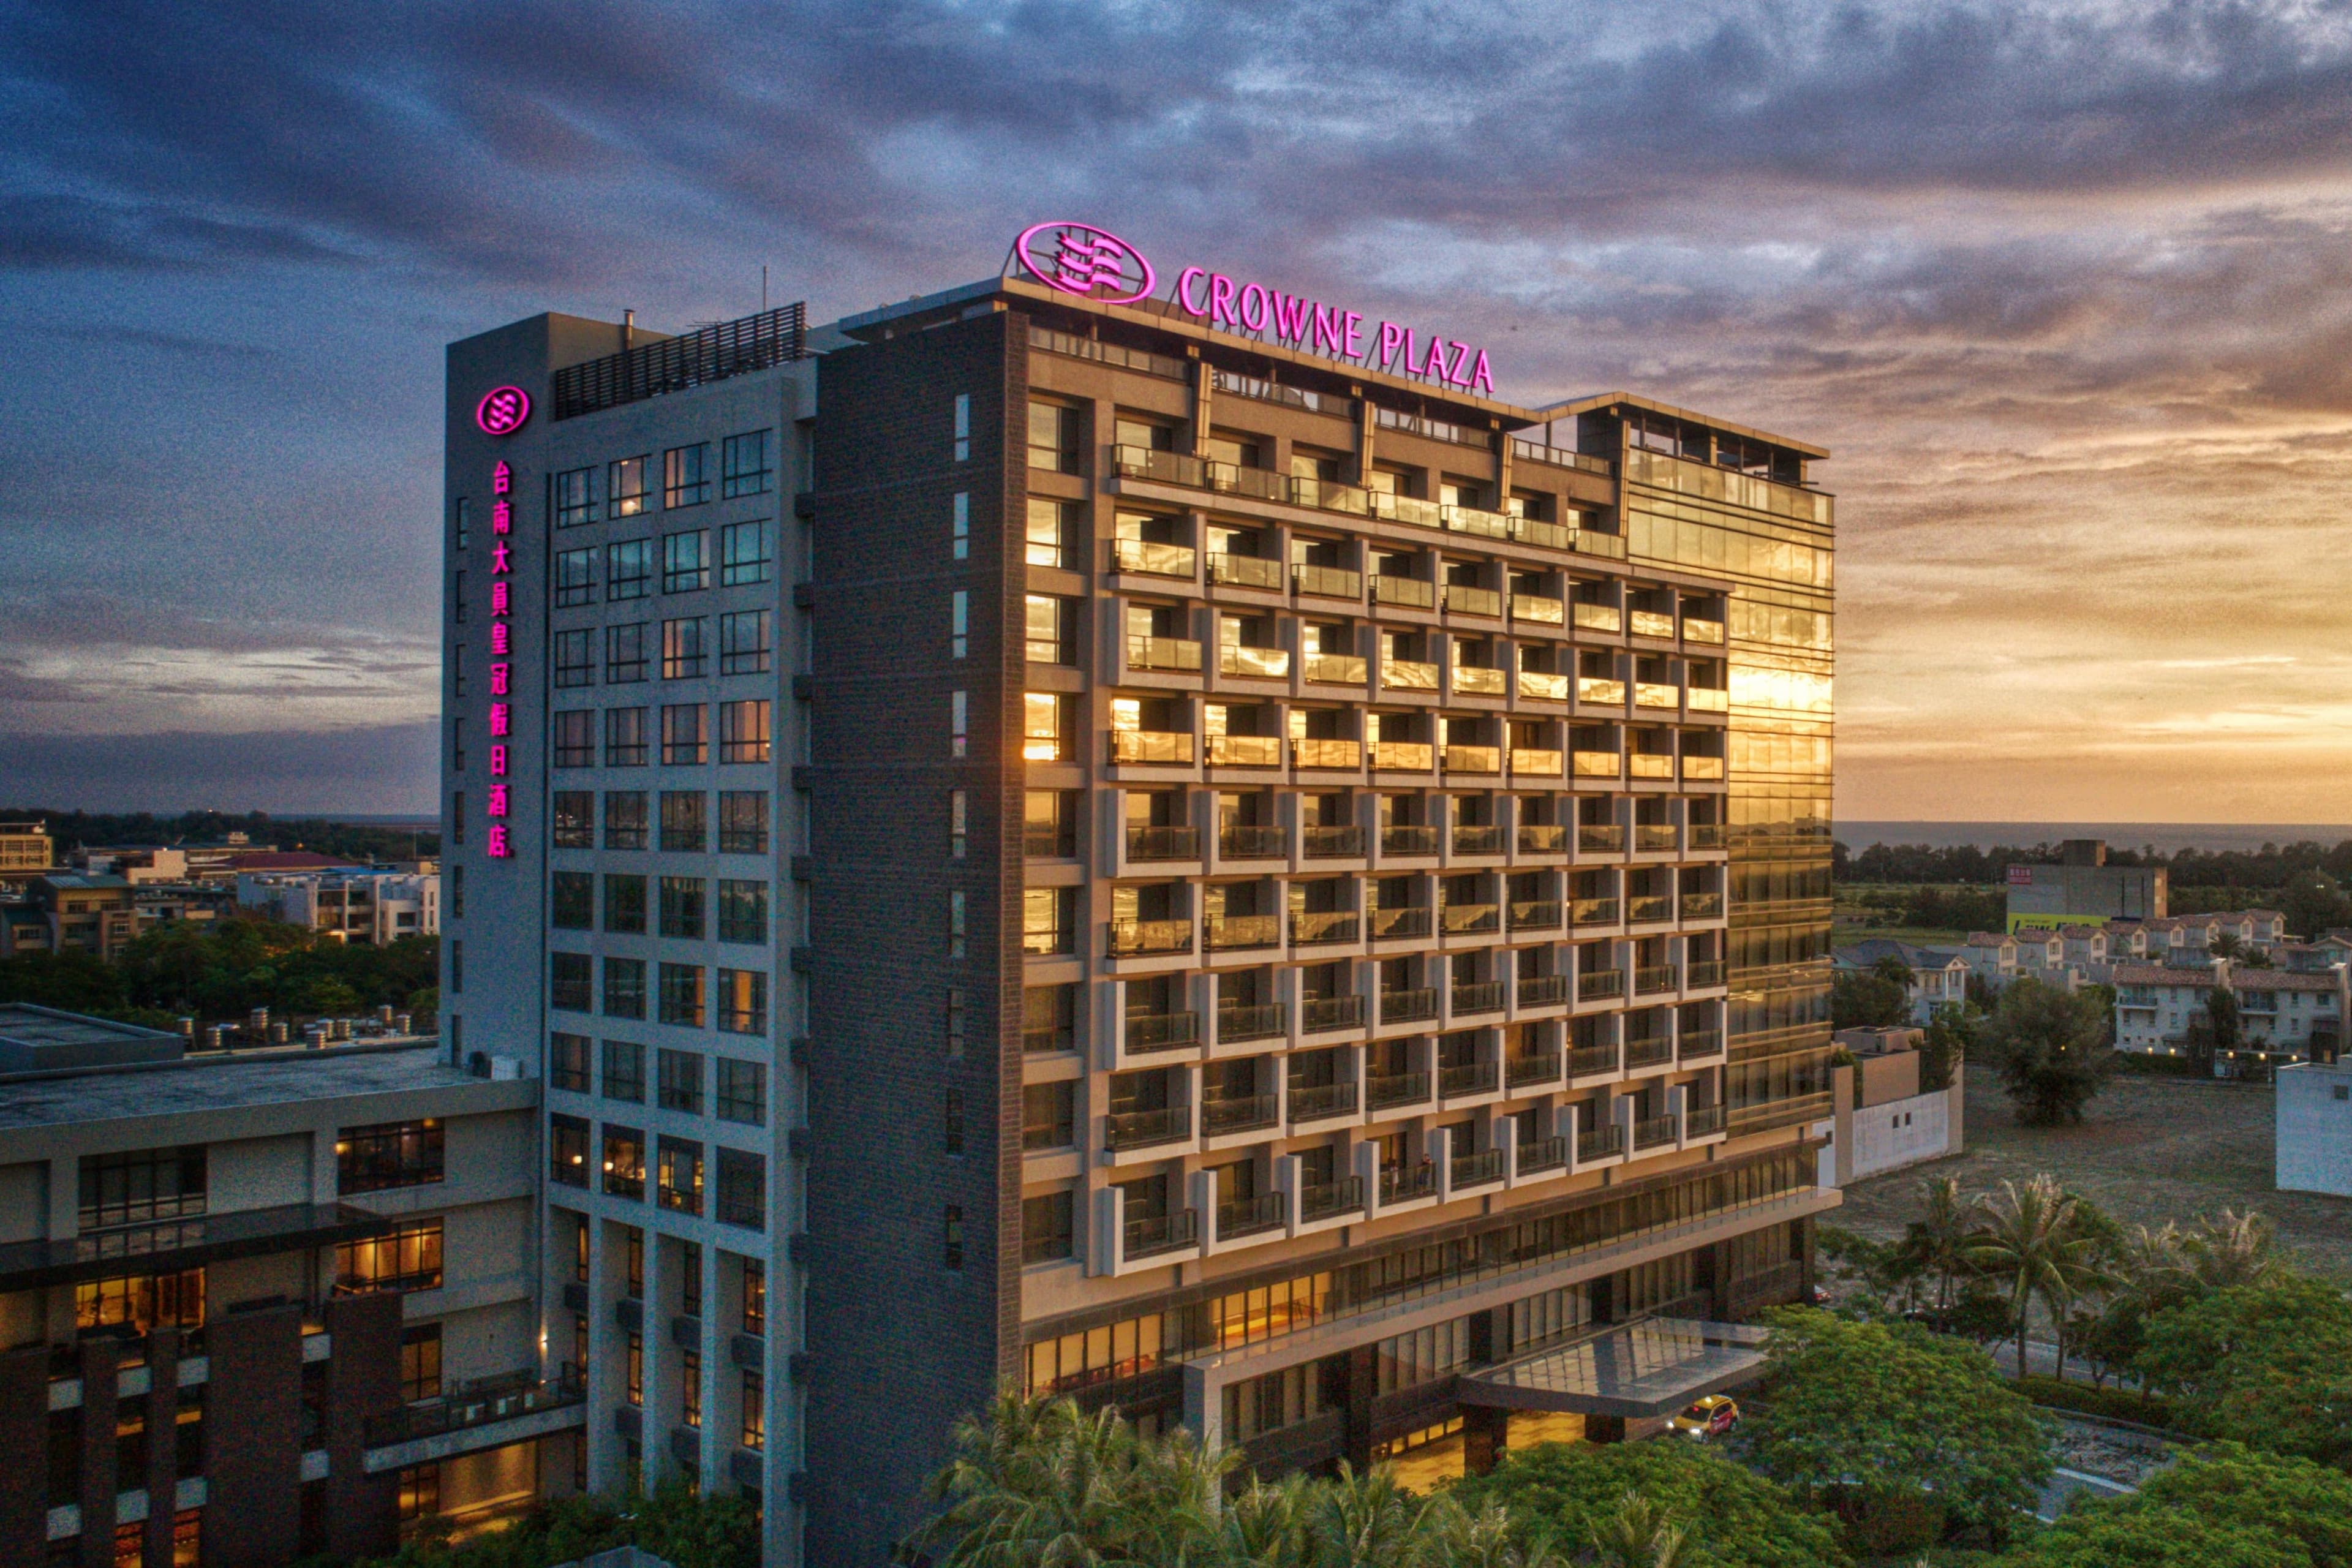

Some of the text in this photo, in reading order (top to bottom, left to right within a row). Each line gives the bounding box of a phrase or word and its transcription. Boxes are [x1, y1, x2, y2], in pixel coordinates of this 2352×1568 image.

[1178, 266, 1495, 393] CROWNE PLAZA
[488, 460, 510, 858] 台南大員皇冠假日酒店
